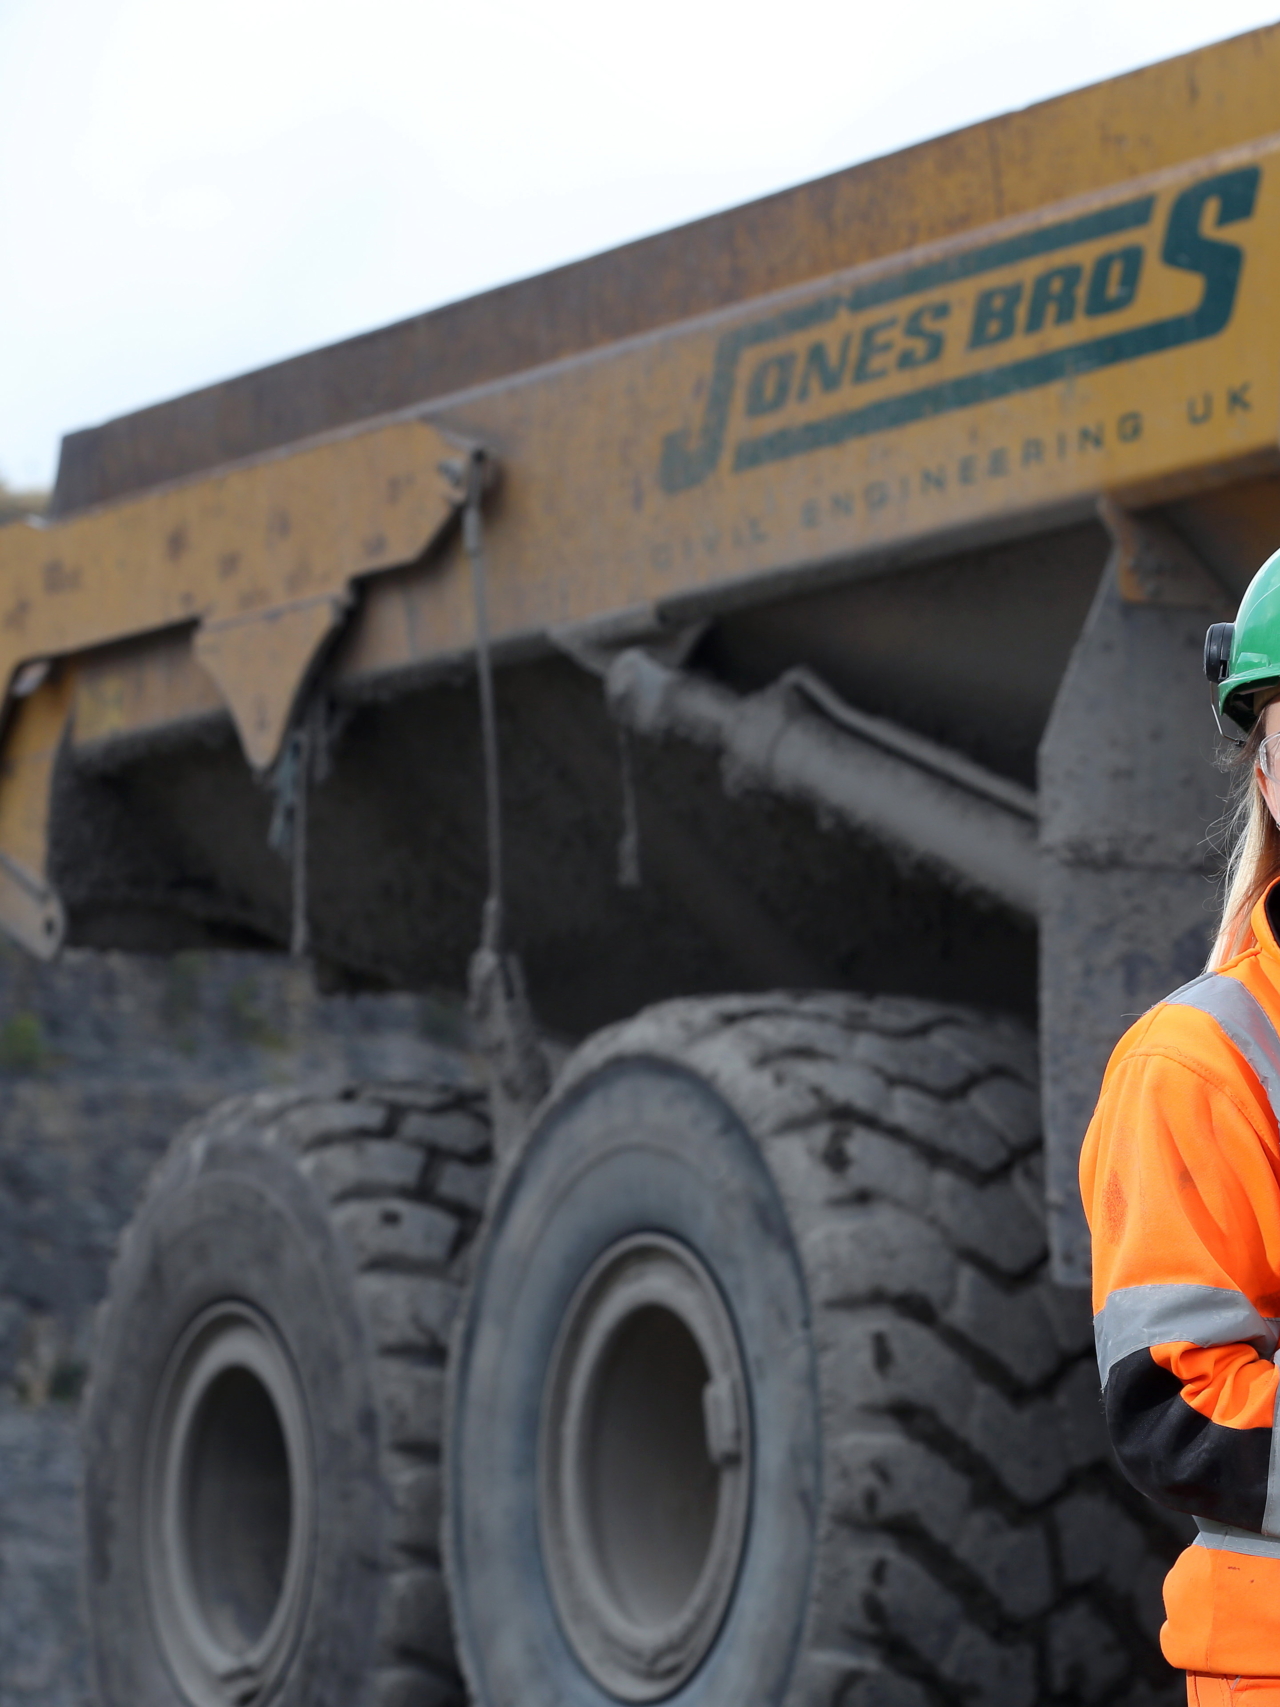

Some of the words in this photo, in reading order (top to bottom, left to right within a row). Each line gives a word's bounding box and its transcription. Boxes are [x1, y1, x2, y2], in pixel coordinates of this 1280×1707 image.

[658, 300, 952, 495] JONES
[964, 164, 1262, 353] BROS
[650, 516, 769, 572] CIVIL
[799, 410, 1143, 530] ENGINEERING
[1187, 381, 1253, 426] UK
